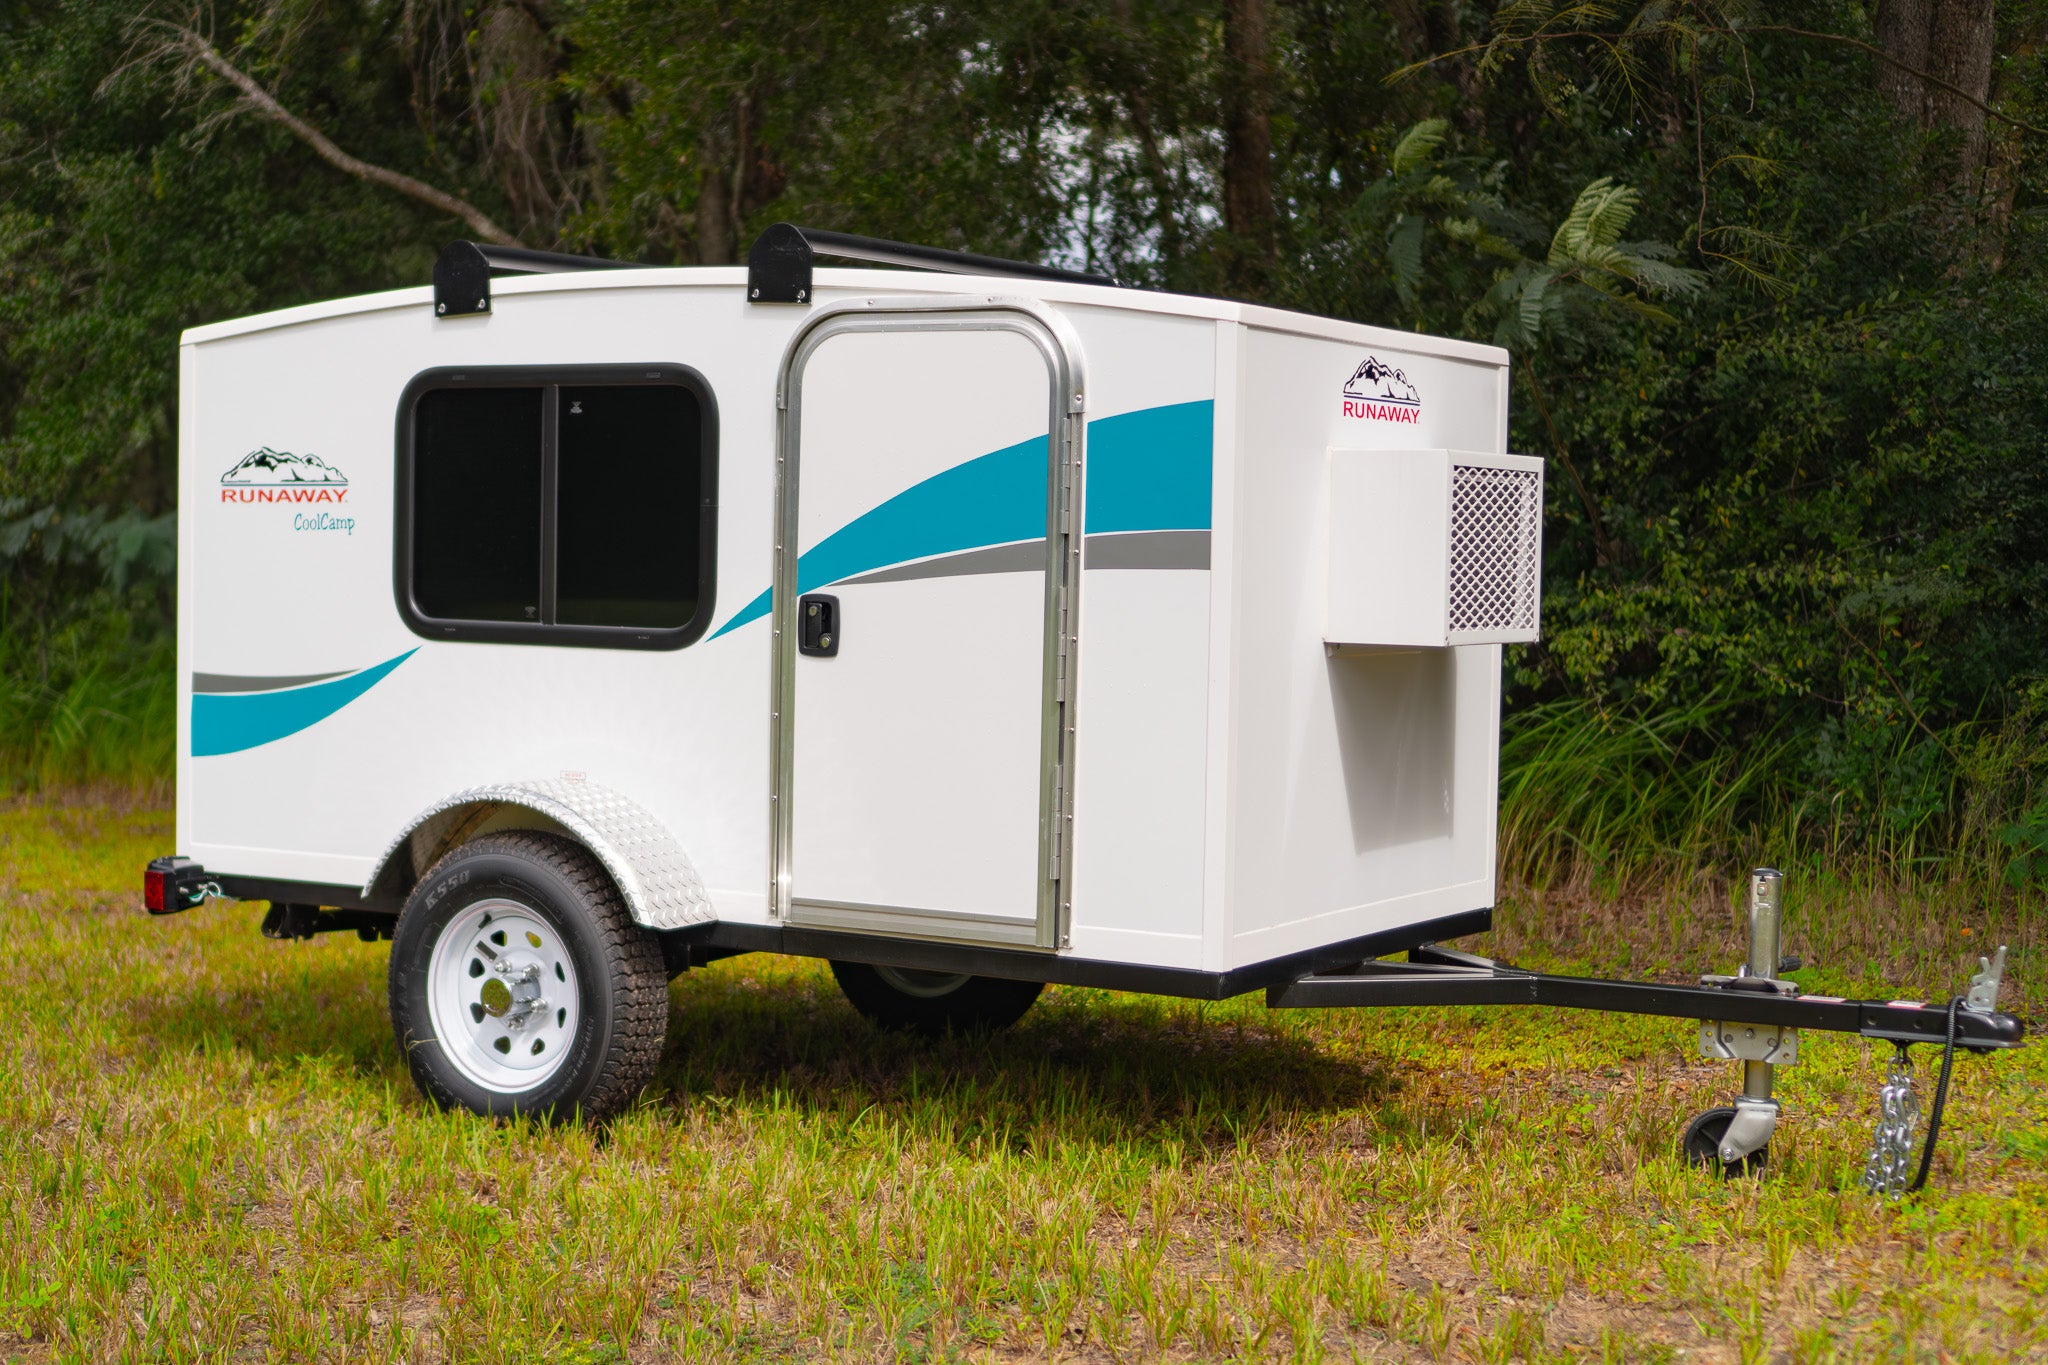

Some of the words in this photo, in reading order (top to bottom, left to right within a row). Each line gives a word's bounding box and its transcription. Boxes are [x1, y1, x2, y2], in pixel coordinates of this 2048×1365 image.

[1343, 401, 1420, 424] RUNAWAY
[221, 489, 348, 503] RUNAWAY
[294, 512, 355, 536] CoolCamp
